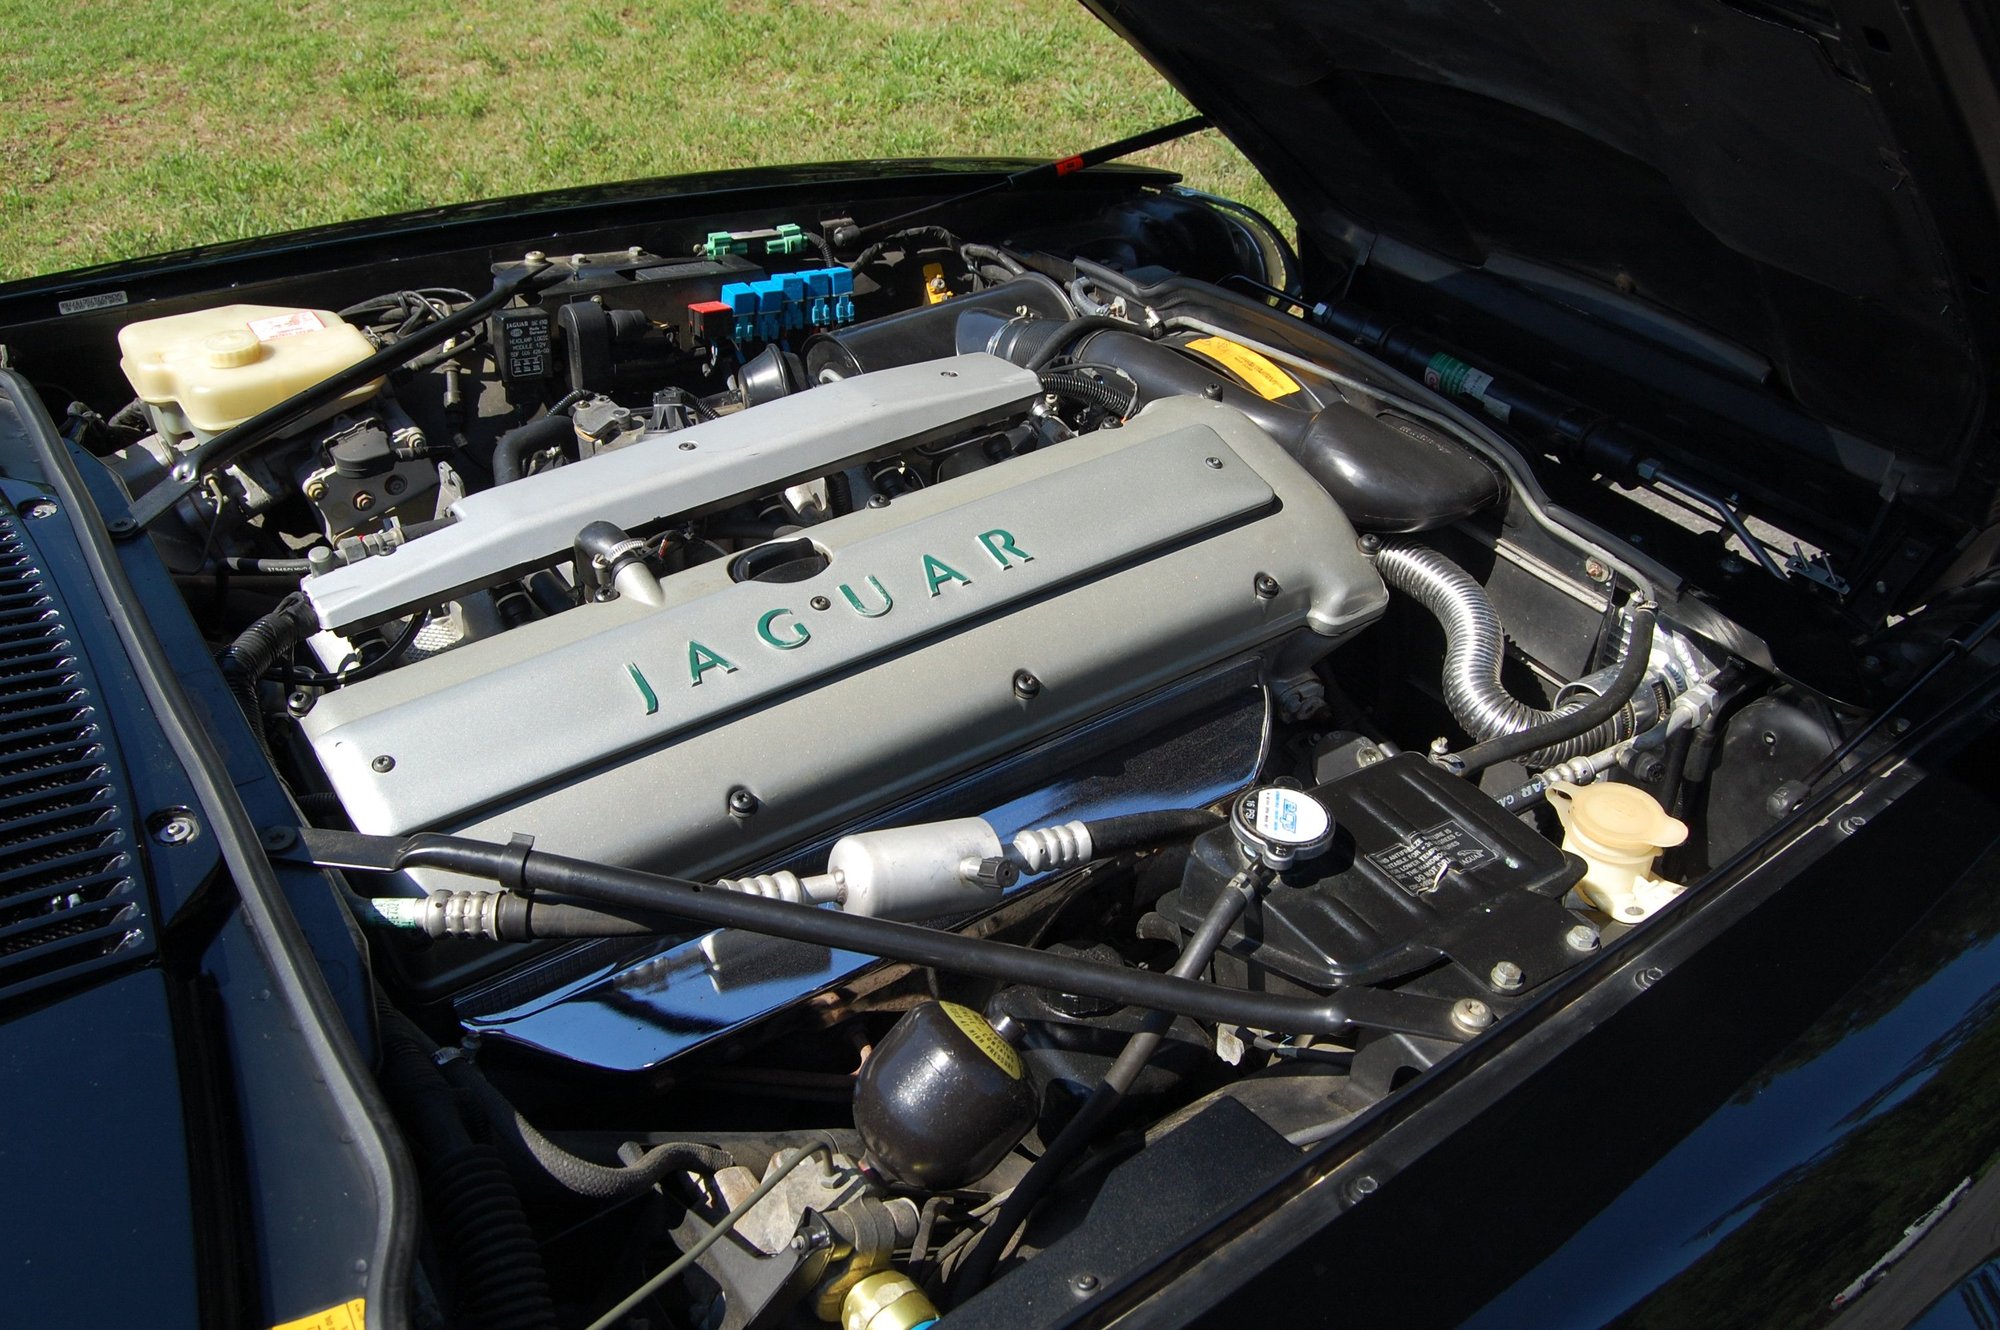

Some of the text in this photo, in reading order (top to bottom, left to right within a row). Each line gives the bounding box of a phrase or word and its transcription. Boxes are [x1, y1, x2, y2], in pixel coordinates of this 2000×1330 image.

[506, 321, 529, 330] JAGUAR
[623, 528, 1035, 715] JAGUAR
[1245, 800, 1256, 820] 16 PSI
[1388, 838, 1424, 862] ANTIFREEZE
[1408, 850, 1421, 859] FOR
[1400, 859, 1420, 872] LOWER
[1407, 866, 1419, 877] THE
[1414, 873, 1426, 882] DO
[1426, 866, 1438, 878] NOT
[969, 1029, 984, 1043] HIGH
[986, 1045, 1013, 1072] PRESSURE
